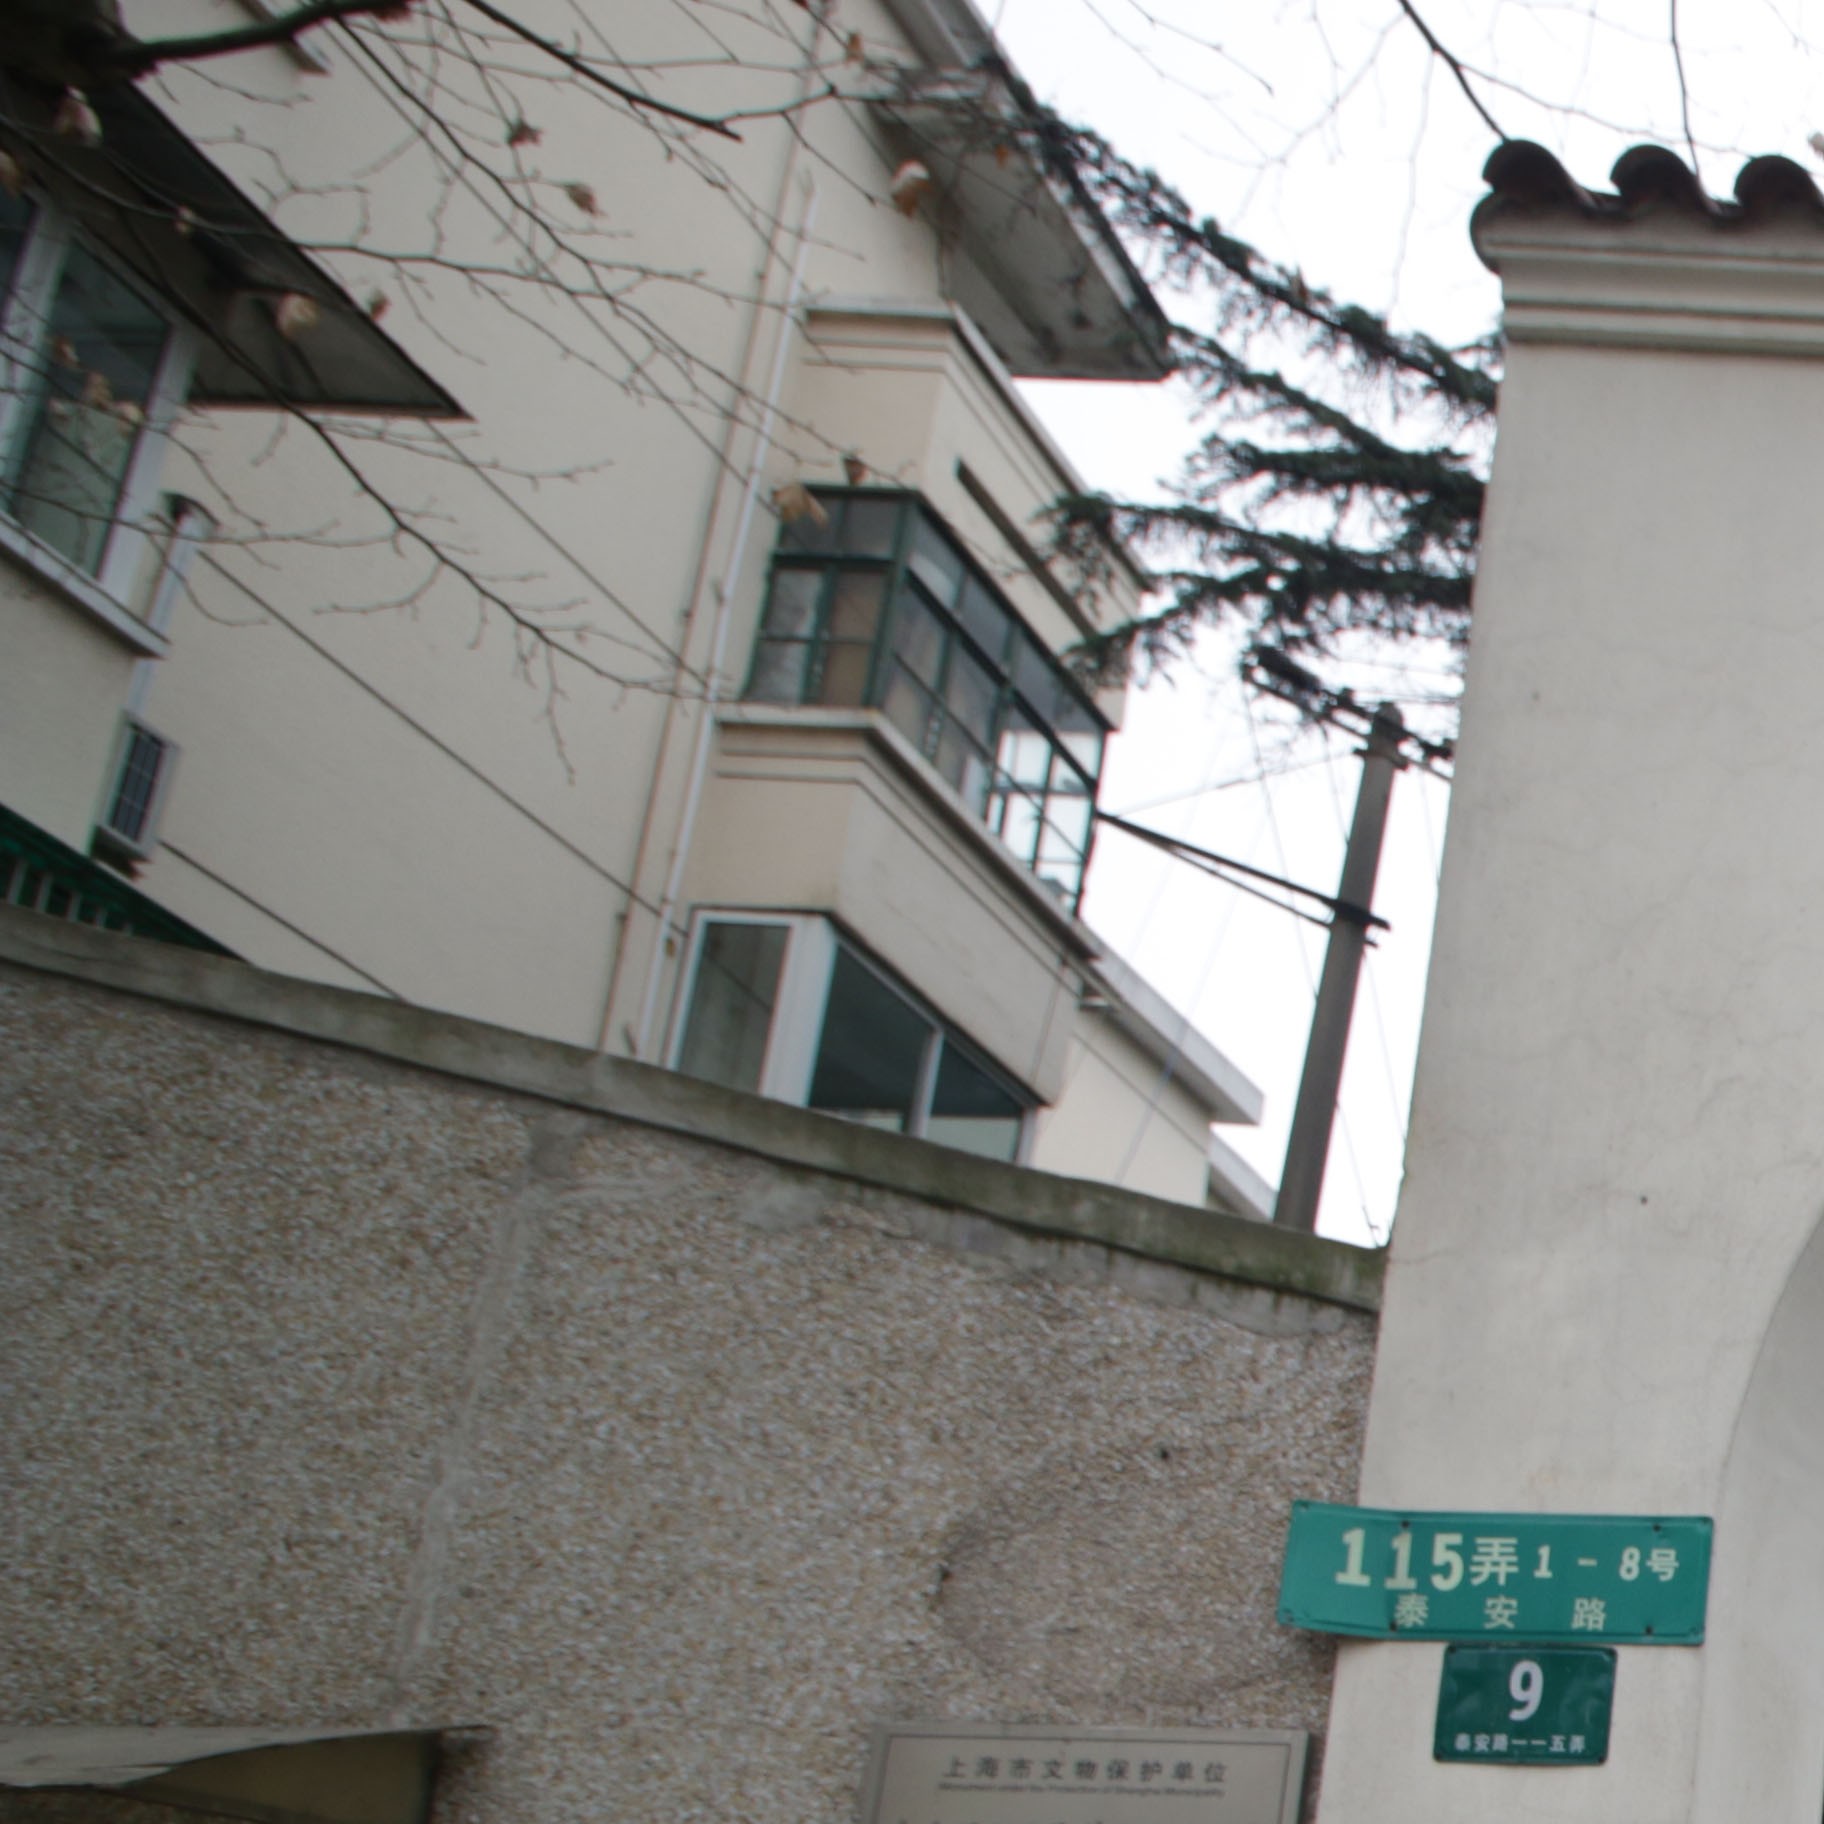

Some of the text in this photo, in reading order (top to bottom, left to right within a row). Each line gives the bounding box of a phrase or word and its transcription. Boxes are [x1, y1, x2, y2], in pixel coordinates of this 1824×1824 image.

[1393, 1593, 1607, 1631] 泰安路
[1508, 1660, 1544, 1721] 9
[942, 1756, 1228, 1783] 上海市文物保护单位
